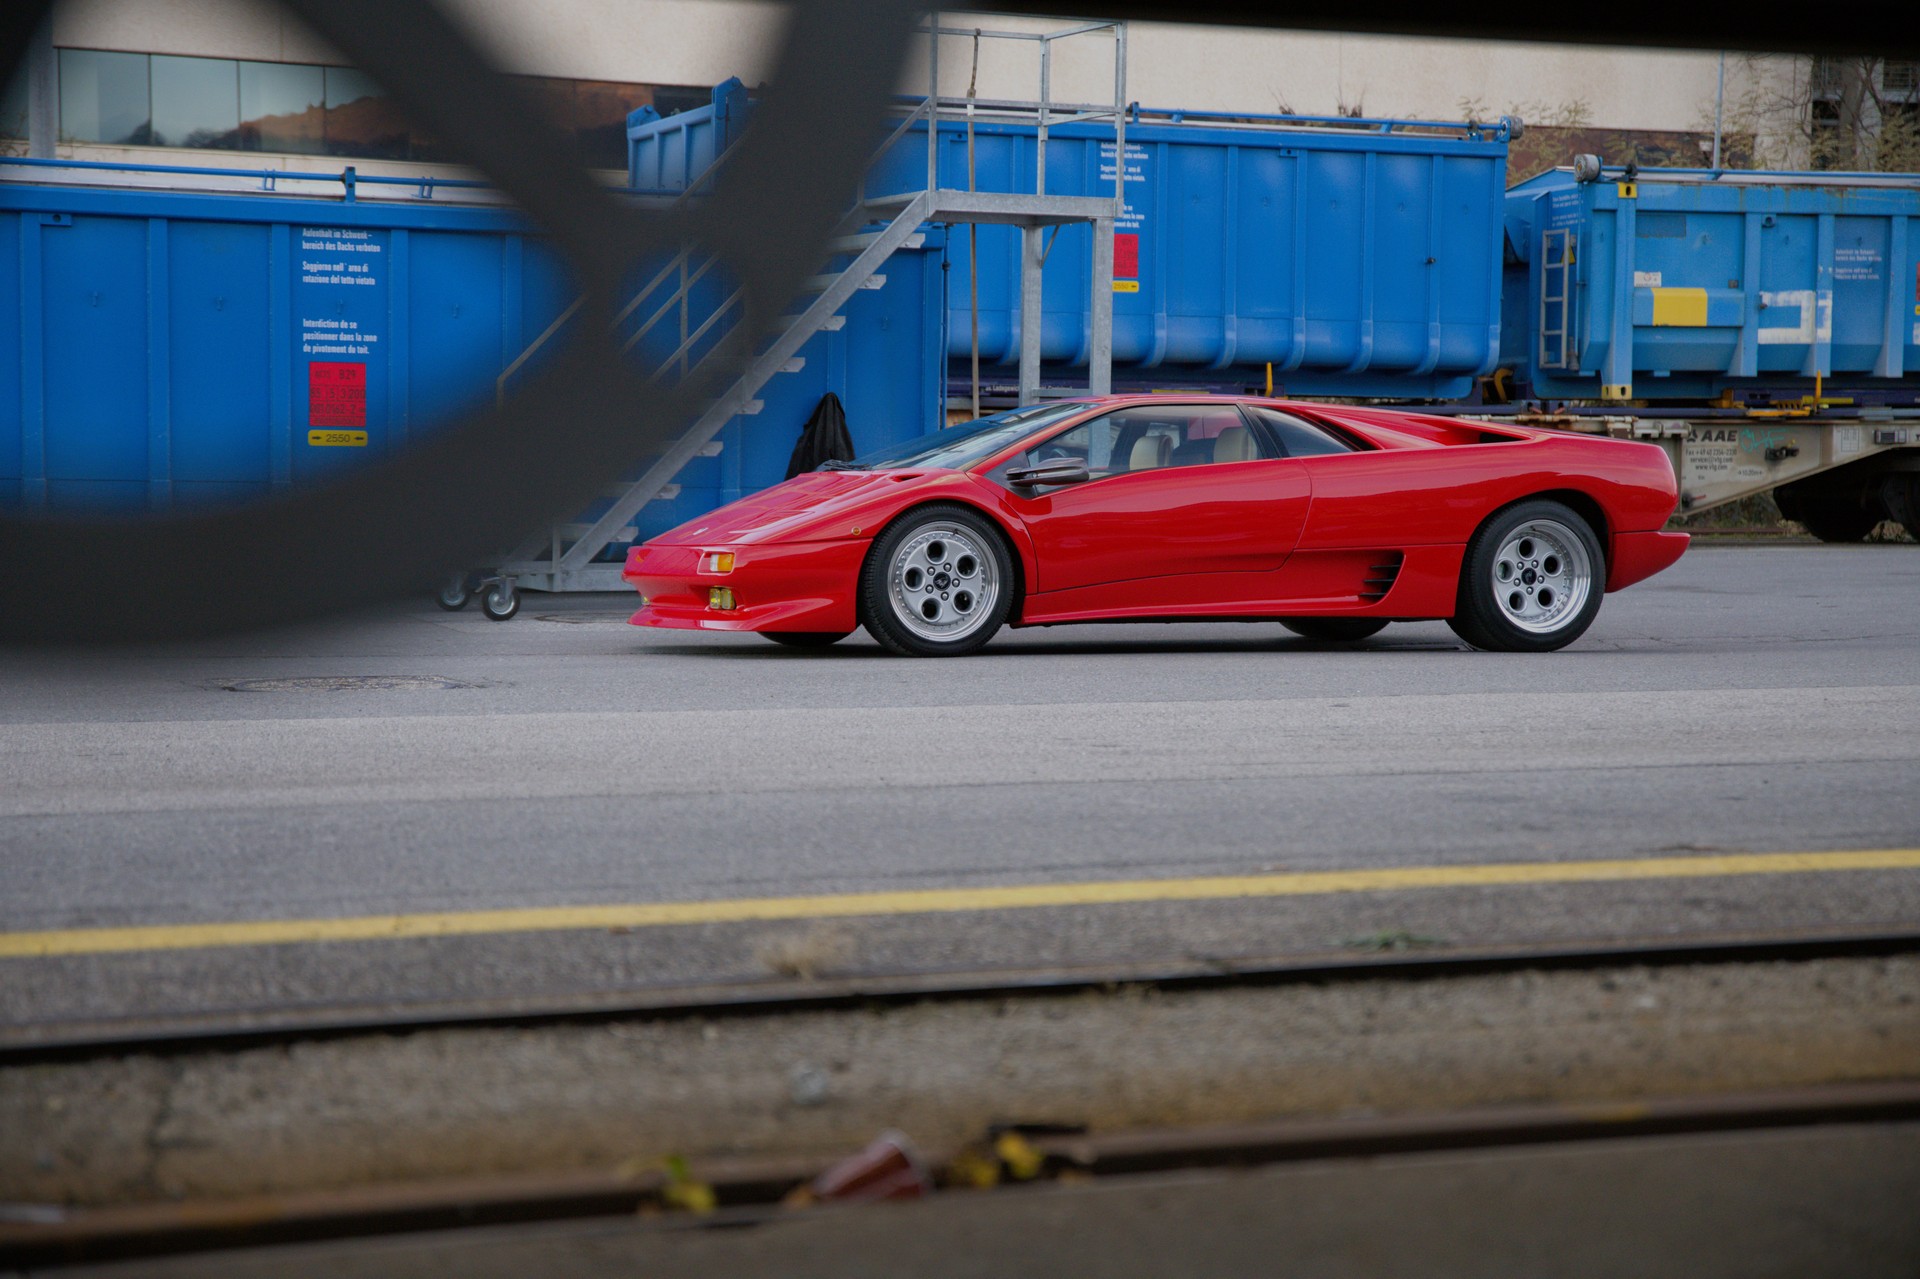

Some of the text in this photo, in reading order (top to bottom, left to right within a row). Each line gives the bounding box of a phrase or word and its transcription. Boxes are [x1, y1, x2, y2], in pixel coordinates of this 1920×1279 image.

[302, 240, 381, 252] bereich des Dachs verboten
[302, 261, 332, 272] Soggiorno
[362, 264, 369, 272] di
[302, 274, 329, 283] rotazione
[330, 275, 340, 284] del
[340, 276, 355, 285] tetto
[303, 318, 357, 329] Interdiction de se
[303, 331, 377, 342] positionner dans la zone
[303, 343, 311, 353] de
[312, 343, 347, 354] pivotement
[348, 345, 356, 354] du
[326, 434, 350, 442] 2550
[1701, 430, 1738, 442] AAE
